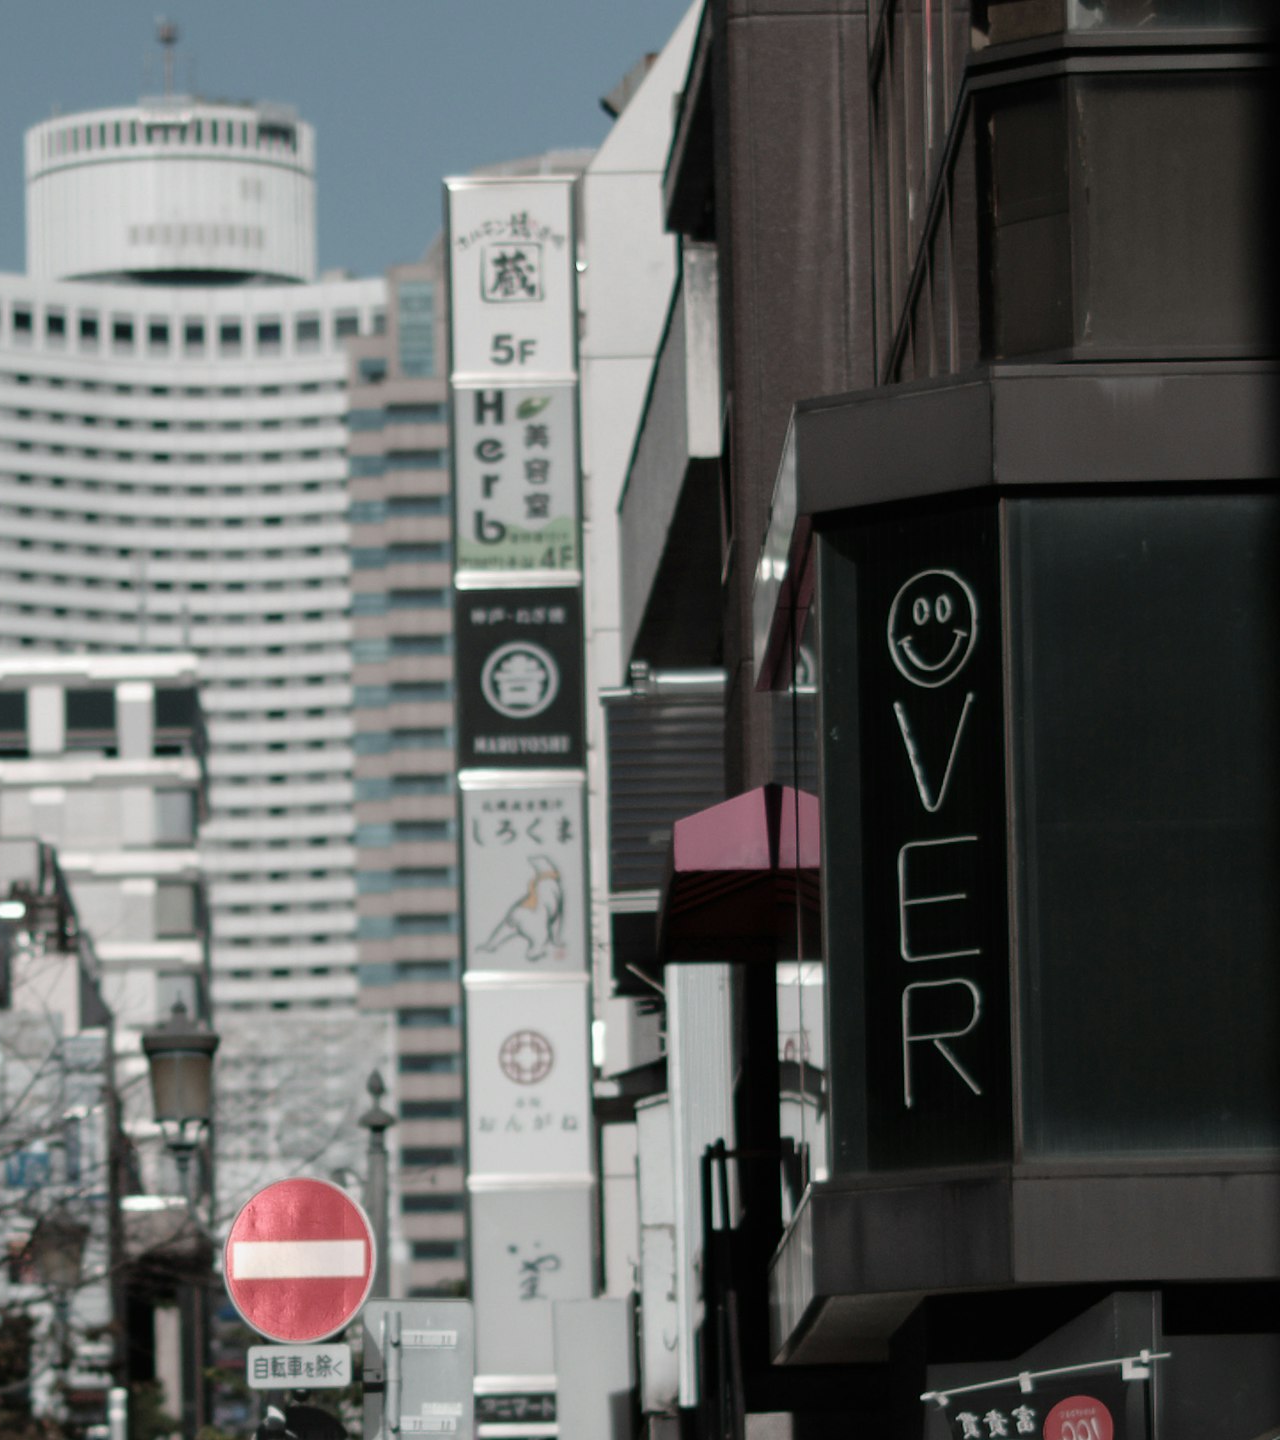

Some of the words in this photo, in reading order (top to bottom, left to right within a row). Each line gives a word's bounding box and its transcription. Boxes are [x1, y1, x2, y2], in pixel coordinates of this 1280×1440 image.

[489, 333, 537, 366] 5F
[474, 389, 508, 545] Herb
[472, 816, 574, 847] しろくま
[254, 1354, 344, 1379] 自転車を除く
